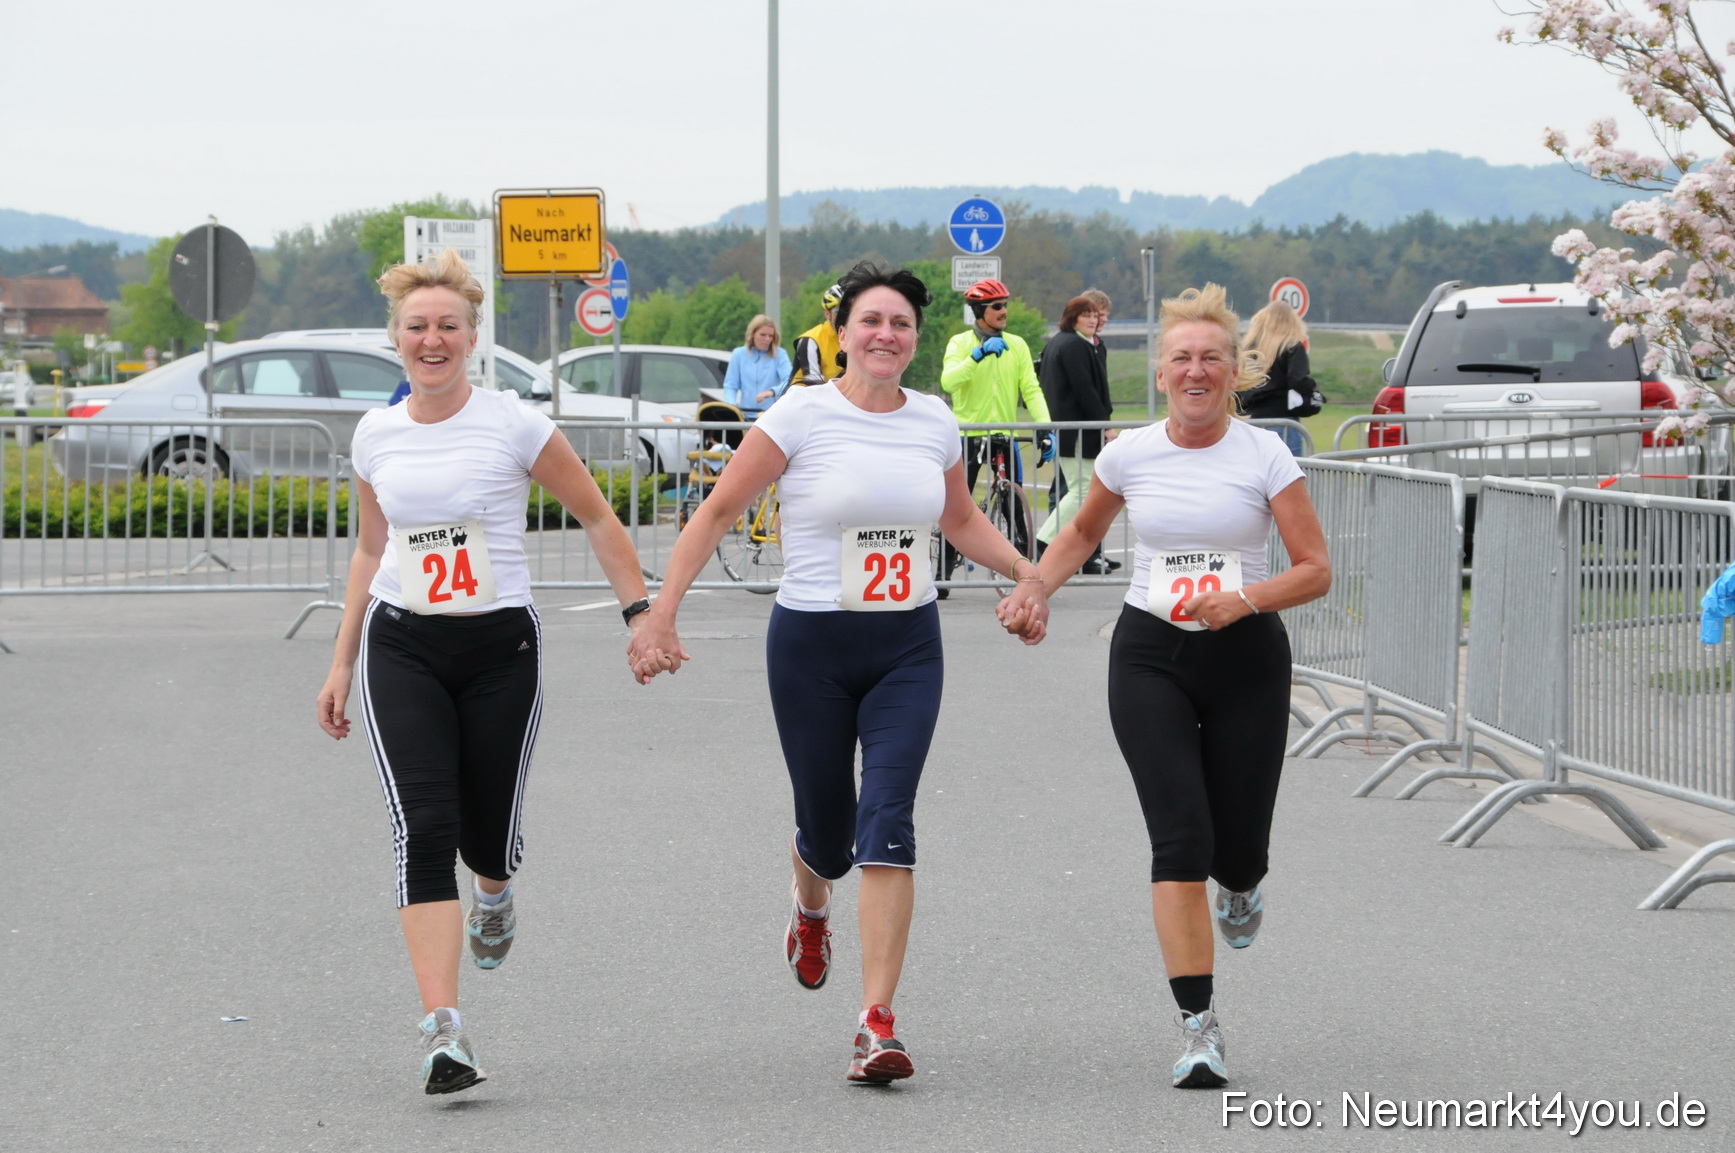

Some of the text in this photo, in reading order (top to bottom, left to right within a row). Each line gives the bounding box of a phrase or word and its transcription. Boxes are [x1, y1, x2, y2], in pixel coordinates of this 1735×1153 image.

[536, 208, 565, 217] Nach
[510, 222, 592, 242] Neumarkt
[538, 249, 567, 260] 5 km
[1509, 394, 1531, 402] KIA
[408, 529, 447, 545] MEYER
[857, 530, 897, 541] MEYER
[409, 539, 450, 552] WERBUNG
[857, 540, 897, 548] WERBUNG
[1165, 553, 1206, 566] MEYER
[1165, 563, 1206, 573] WERBUNG
[422, 548, 478, 604] 24
[863, 552, 911, 602] 23
